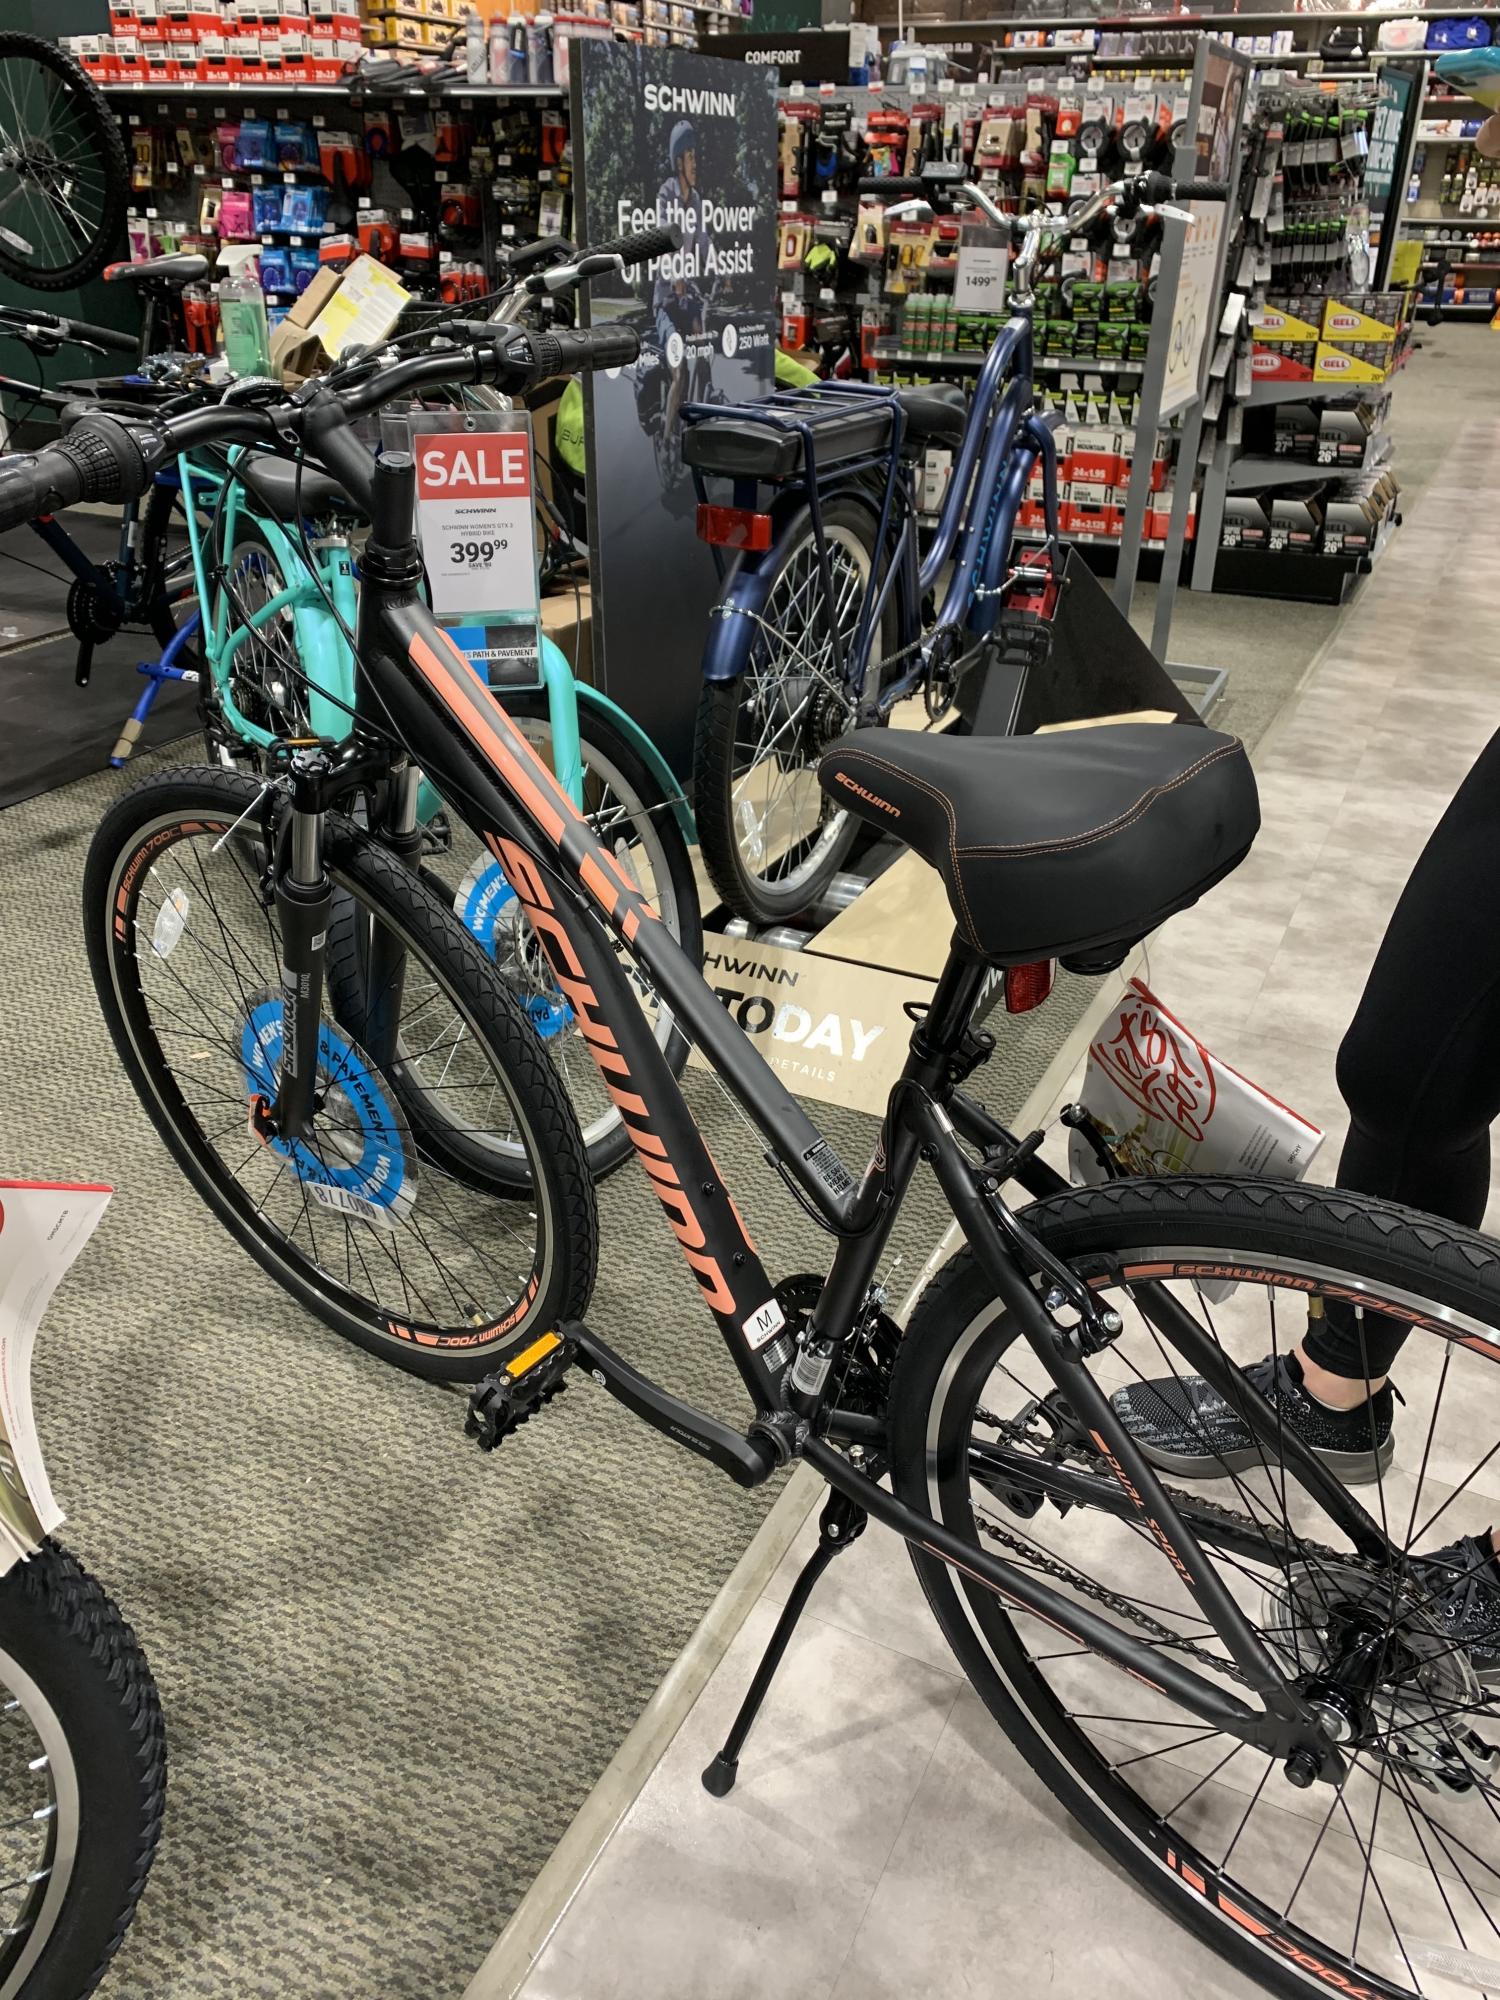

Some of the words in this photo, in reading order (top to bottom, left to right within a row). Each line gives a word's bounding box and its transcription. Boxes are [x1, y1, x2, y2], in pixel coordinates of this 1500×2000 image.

[744, 50, 800, 65] COMFORT
[644, 84, 735, 117] SCHWINN
[617, 199, 660, 236] Feel
[666, 198, 697, 233] the
[701, 199, 756, 233] Power
[648, 243, 700, 281] Pedal
[704, 241, 753, 276] Assist
[965, 276, 990, 287] 1499
[1333, 318, 1355, 326] BELL
[686, 345, 696, 359] 20
[697, 343, 714, 360] mph
[739, 336, 752, 351] 250
[753, 334, 770, 347] Watt
[639, 353, 660, 368] Miles
[1323, 360, 1345, 368] BELL
[423, 449, 525, 487] SALE
[497, 648, 534, 657] PAVEMENT
[835, 772, 901, 817] SCHWINN
[123, 848, 148, 889] SCHWINN
[146, 827, 181, 850] 700C
[473, 872, 509, 930] WOMEN'S
[703, 951, 799, 987] HWINN
[714, 986, 885, 1061] TODAY
[252, 1019, 283, 1068] WOMEN'S
[484, 830, 737, 1315] SCHWINN
[331, 1051, 389, 1146] PAVEMENT
[352, 1153, 391, 1200] WOMEN'S
[1178, 1264, 1316, 1292] SCHWINN
[756, 1309, 773, 1332] M
[756, 1321, 781, 1343] SCHWINN
[438, 1335, 478, 1346] 700C
[1107, 1455, 1146, 1509] DUAL
[1145, 1516, 1196, 1585] SPORT
